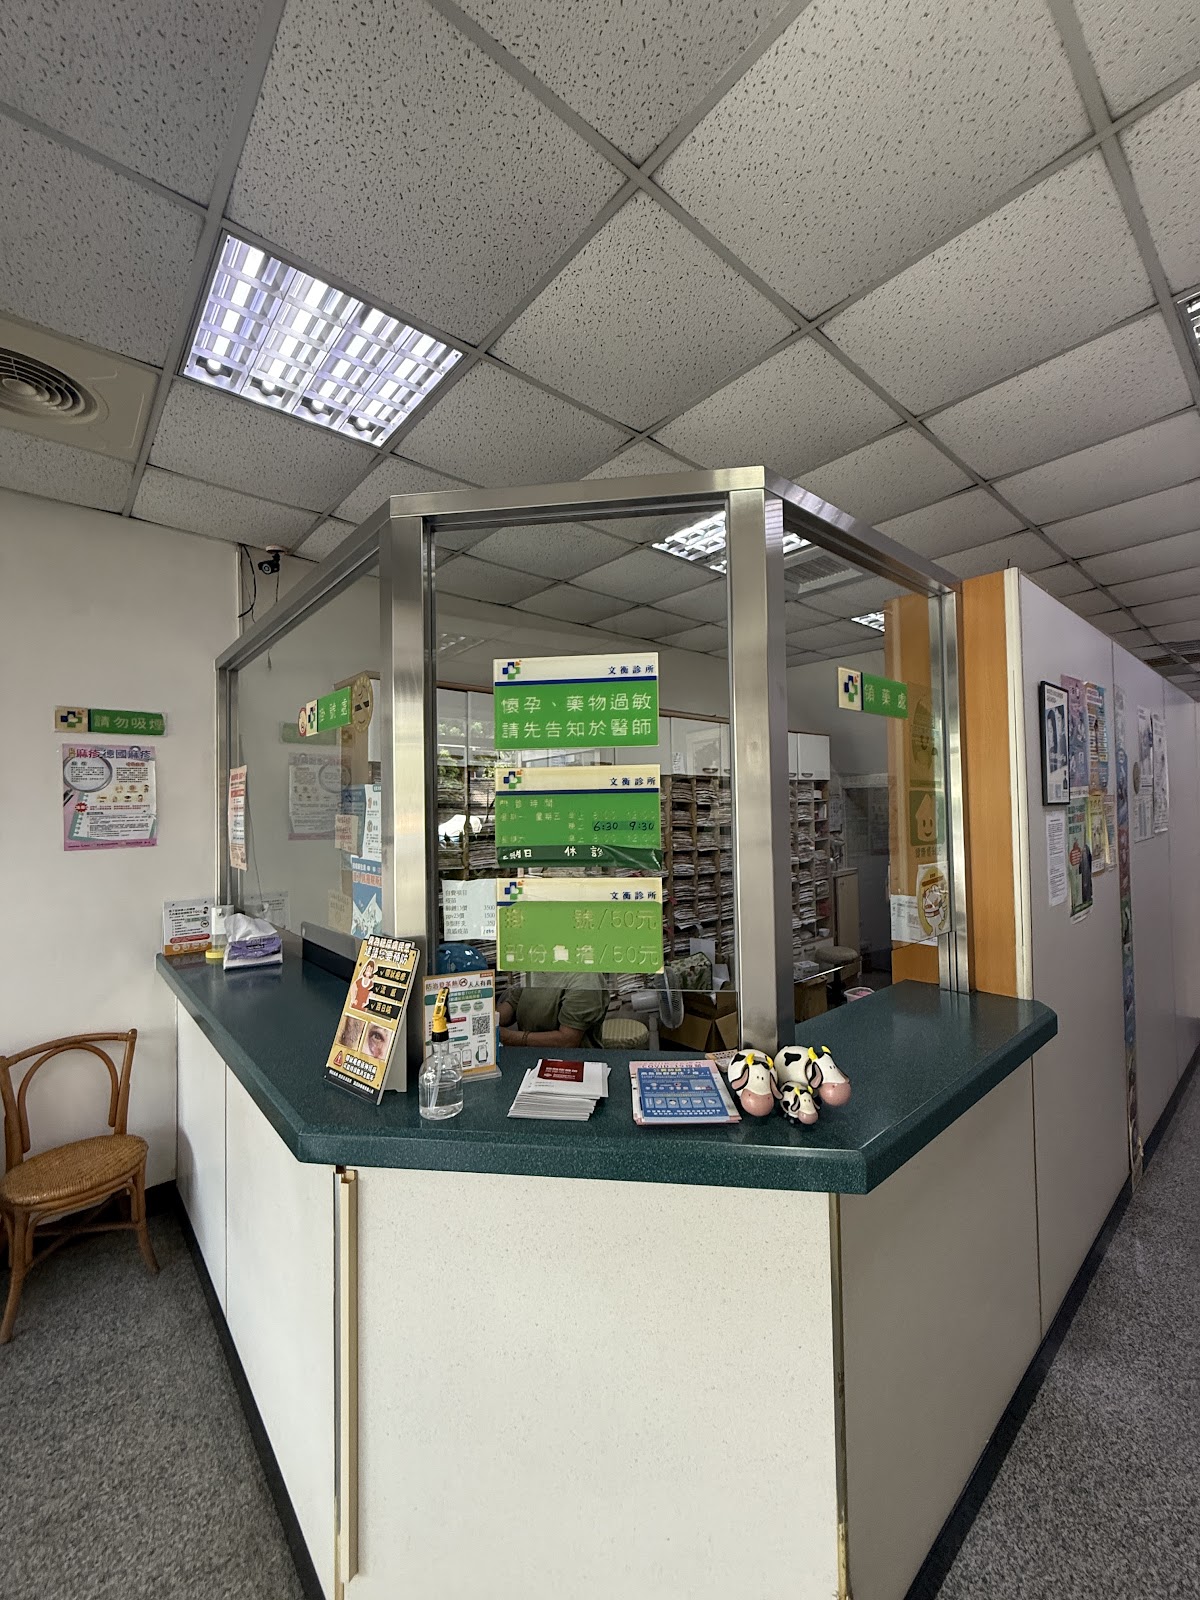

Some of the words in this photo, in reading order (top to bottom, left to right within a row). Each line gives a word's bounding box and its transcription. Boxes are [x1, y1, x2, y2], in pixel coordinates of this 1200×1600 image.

[608, 664, 654, 675] 文衡診所
[501, 692, 652, 714] 懷孕、藥物過敏
[501, 718, 652, 739] 請先告知於醫師
[610, 776, 656, 786] 文衡診所
[593, 821, 618, 832] 6:30
[629, 821, 655, 831] 9:30
[610, 891, 657, 900] 文衡診所
